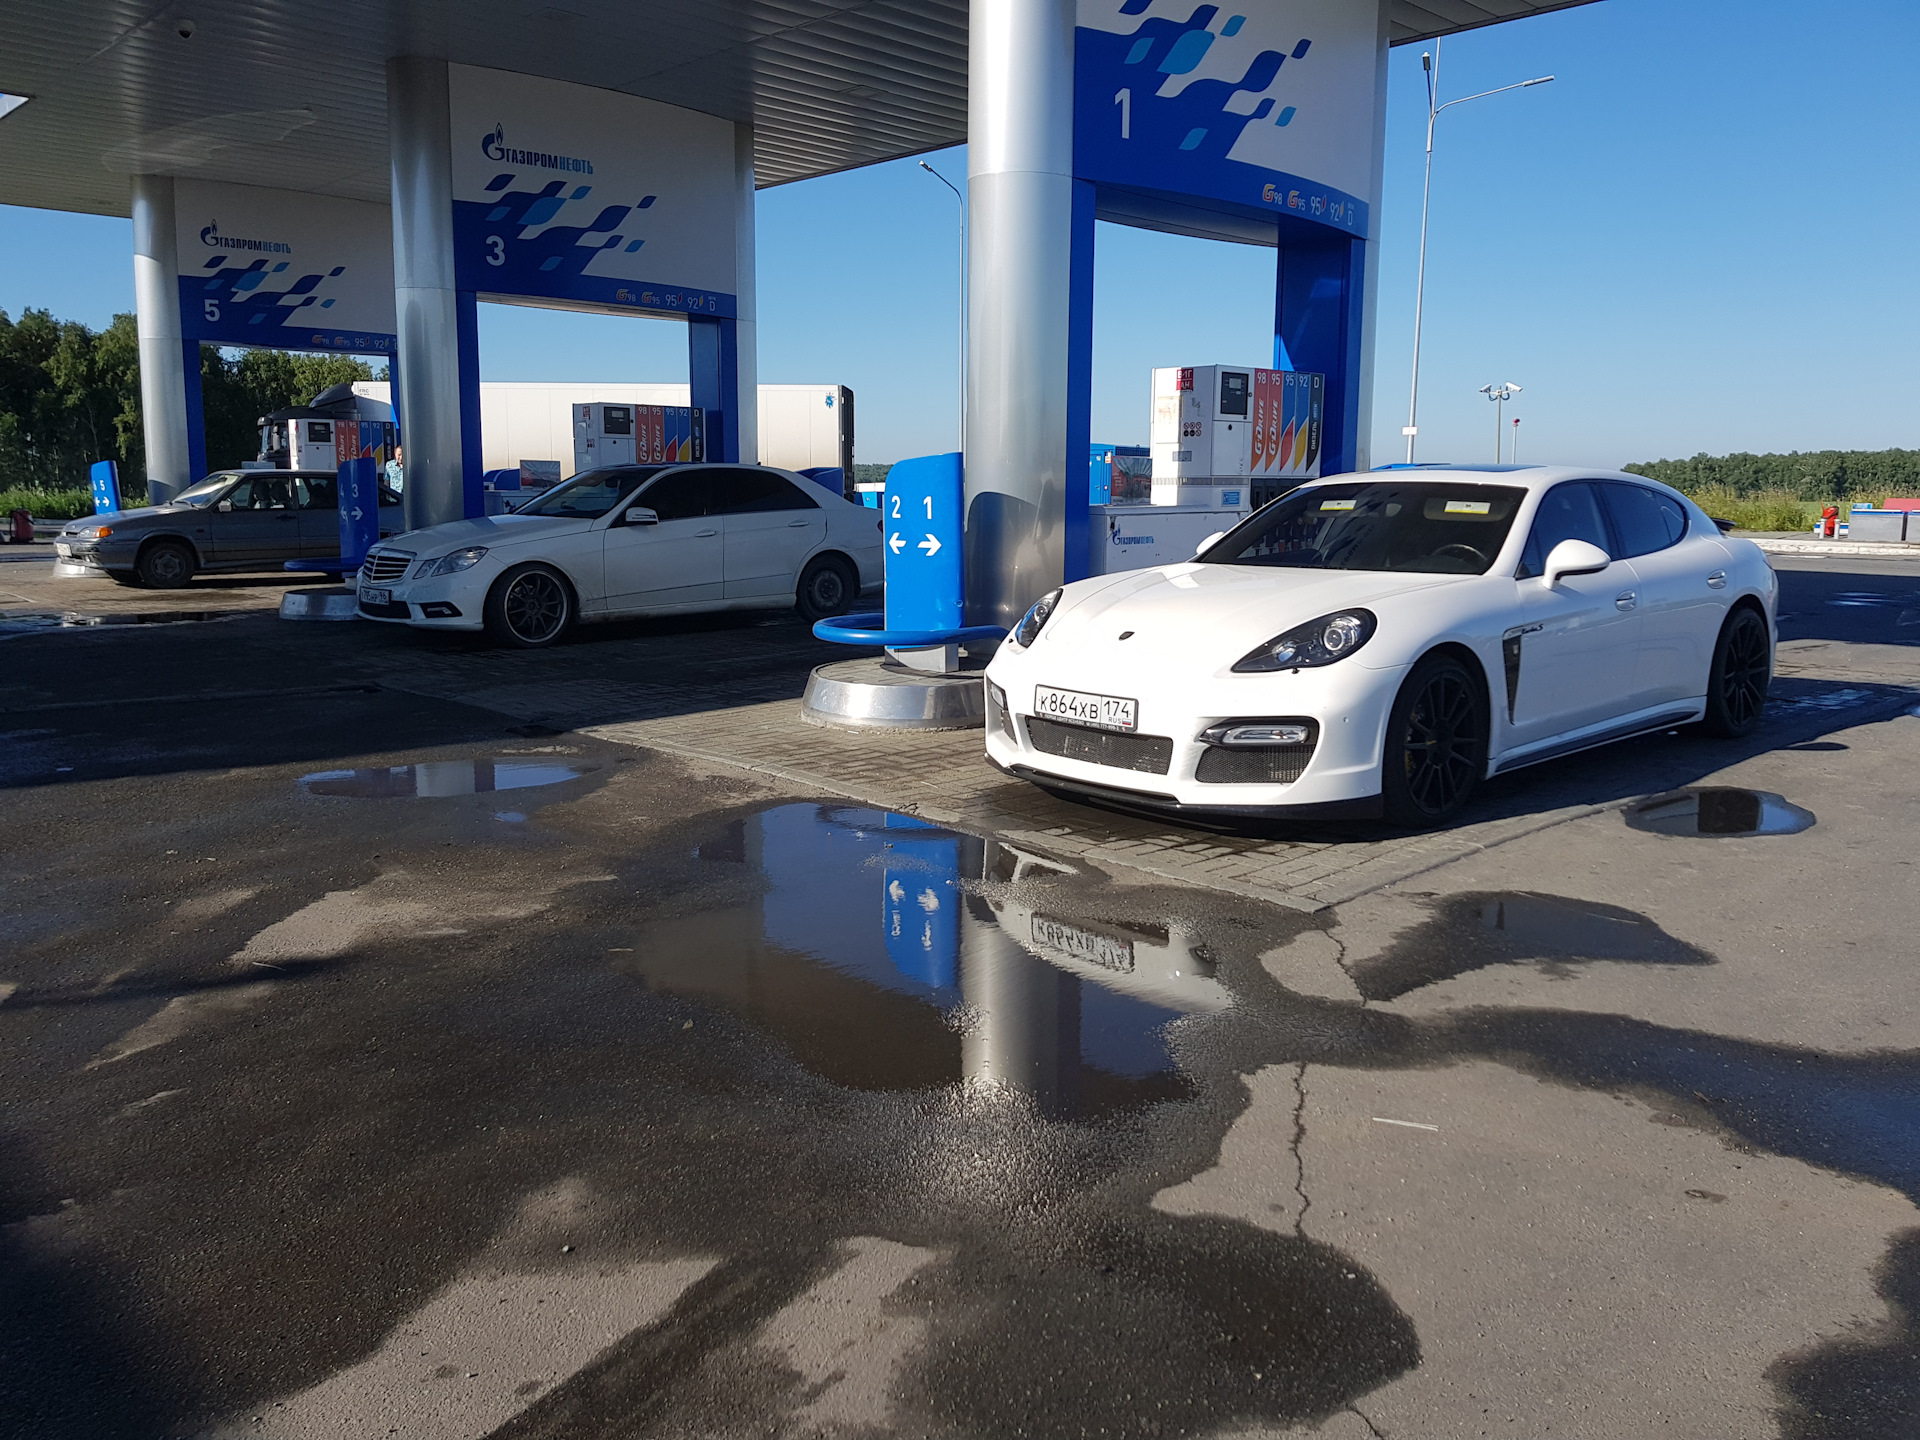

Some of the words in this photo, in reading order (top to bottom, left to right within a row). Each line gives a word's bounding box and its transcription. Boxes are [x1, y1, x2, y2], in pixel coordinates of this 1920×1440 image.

[1114, 88, 1131, 139] 1
[505, 148, 594, 175] ГАЗПРОМНЕФТЬ
[1310, 196, 1321, 215] 95
[1330, 202, 1340, 221] 92
[220, 236, 292, 254] ГАЗПРОМНЕФТЬ
[485, 235, 505, 266] 3
[665, 294, 677, 307] 95
[687, 297, 699, 309] 92
[204, 299, 220, 322] 5
[354, 337, 365, 347] 95
[374, 339, 385, 349] 92
[1257, 372, 1267, 384] 98
[1271, 373, 1281, 385] 95
[1285, 374, 1295, 387] 95
[1299, 375, 1308, 388] 92
[1313, 376, 1320, 389] D
[638, 406, 648, 415] 98
[652, 407, 661, 416] 95
[665, 408, 675, 416] 95
[679, 408, 688, 417] 92
[694, 409, 700, 418] D
[100, 480, 105, 490] 5
[352, 483, 359, 498] 3
[892, 495, 901, 518] 2
[923, 495, 932, 520] 1
[1040, 693, 1099, 719] К864ХВ
[1103, 700, 1129, 718] 174
[1107, 716, 1122, 725] RUS
